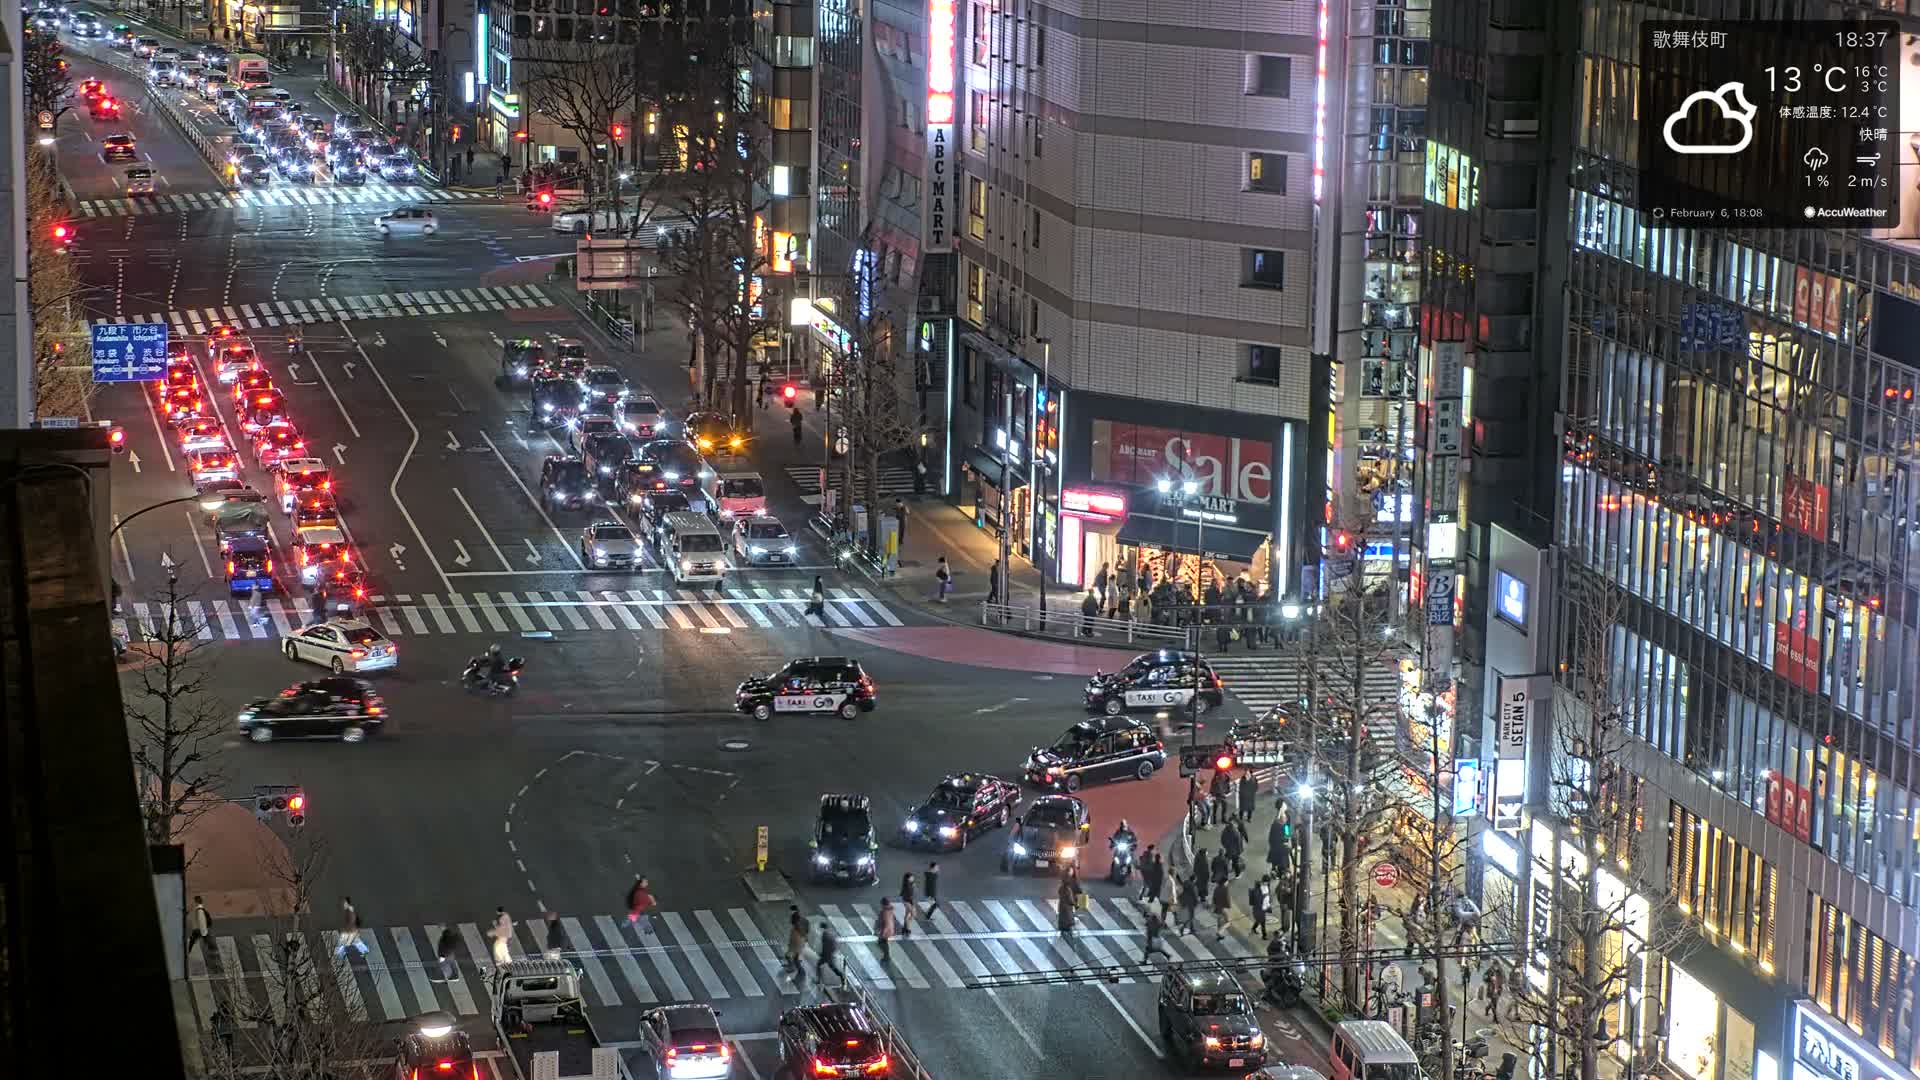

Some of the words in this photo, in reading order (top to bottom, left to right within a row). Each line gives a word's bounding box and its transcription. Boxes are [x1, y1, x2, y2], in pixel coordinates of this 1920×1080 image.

[933, 128, 945, 244] ABC-MART
[98, 326, 127, 335] 九段下
[1165, 436, 1272, 505] Sale
[1438, 515, 1449, 523] 7F
[1513, 692, 1525, 702] 5
[1503, 703, 1512, 719] CITY
[1502, 721, 1511, 740] PARK
[1512, 705, 1525, 746] ISETAN
